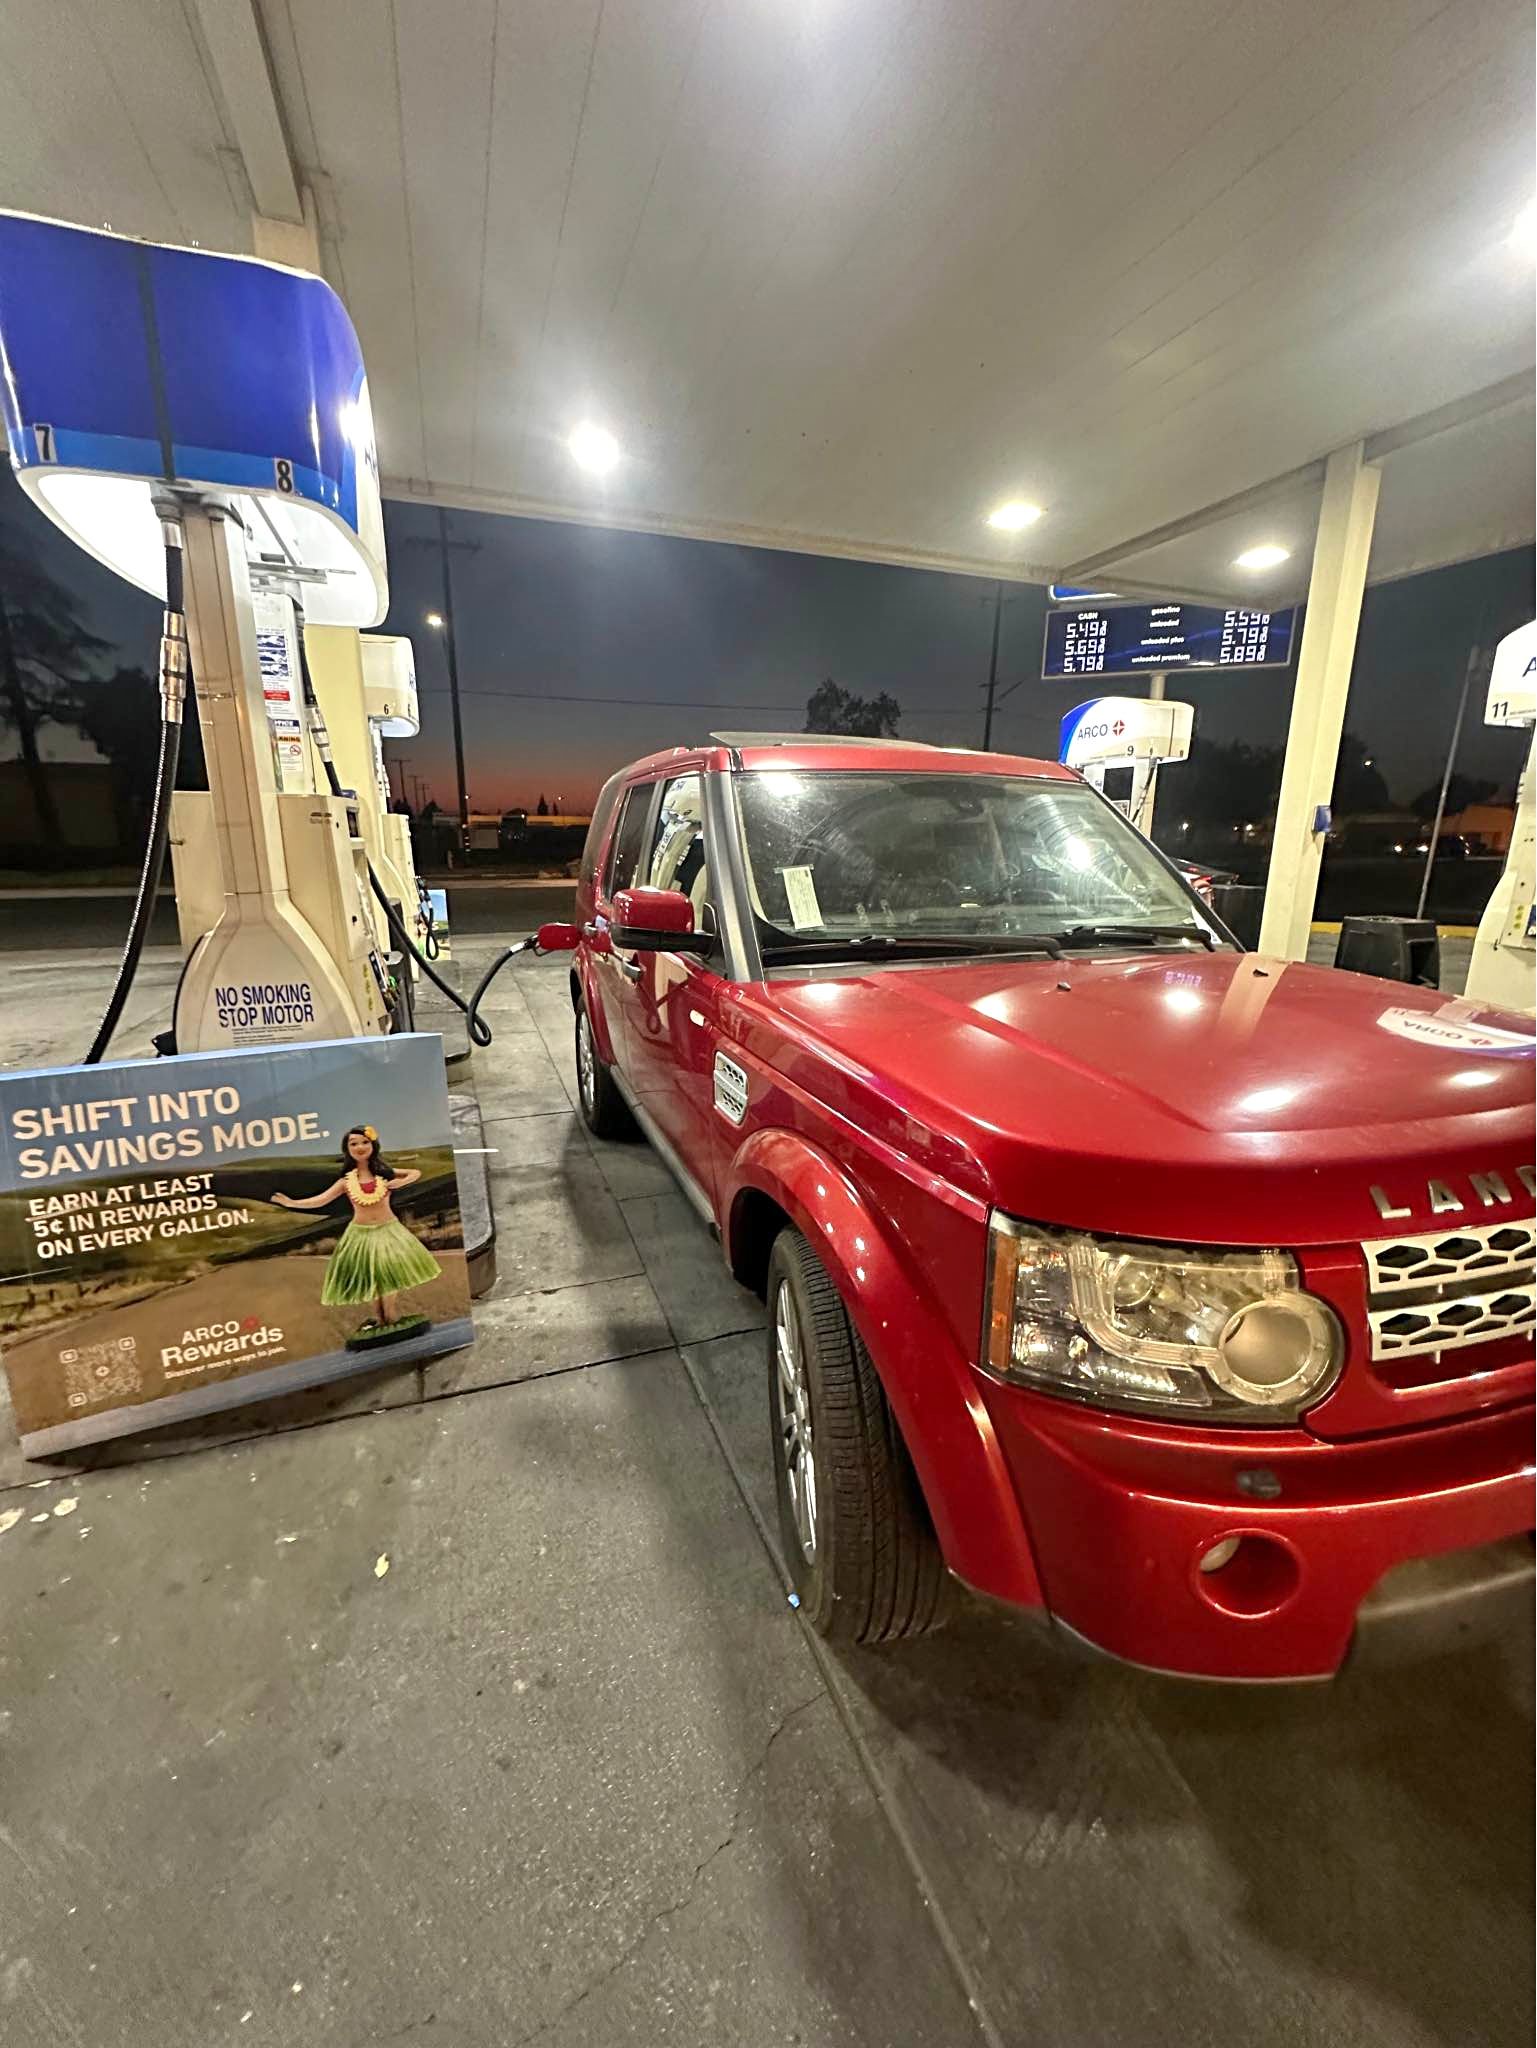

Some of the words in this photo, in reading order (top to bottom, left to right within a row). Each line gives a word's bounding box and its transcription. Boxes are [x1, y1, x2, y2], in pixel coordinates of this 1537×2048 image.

[35, 426, 50, 460] 7
[277, 460, 291, 493] 8
[384, 704, 389, 715] 6
[1492, 701, 1508, 718] 11
[1078, 724, 1108, 739] ARCO
[1127, 745, 1134, 756] 9
[215, 987, 238, 1007] NO
[241, 984, 311, 1006] SMOKING
[219, 1007, 258, 1028] STOP
[262, 1004, 314, 1025] MOTOR
[12, 1098, 138, 1140] SHIFT
[148, 1086, 240, 1124] INTO
[18, 1128, 204, 1179] SAVINGS
[212, 1112, 330, 1153] MODE.
[29, 1191, 99, 1217] EARN
[105, 1185, 134, 1205] AT
[140, 1173, 214, 1200] LEAST
[33, 1219, 63, 1238] 5¢
[69, 1212, 95, 1233] IN
[100, 1194, 218, 1227] REWARDS
[37, 1239, 73, 1259] ON
[78, 1224, 154, 1252] EVERY
[159, 1209, 255, 1238] GALLON.
[160, 1326, 284, 1367] Rewards
[181, 1320, 240, 1345] ARCO
[164, 1364, 206, 1379] Discover
[207, 1358, 232, 1369] more
[232, 1353, 257, 1364] ways
[257, 1349, 267, 1357] to
